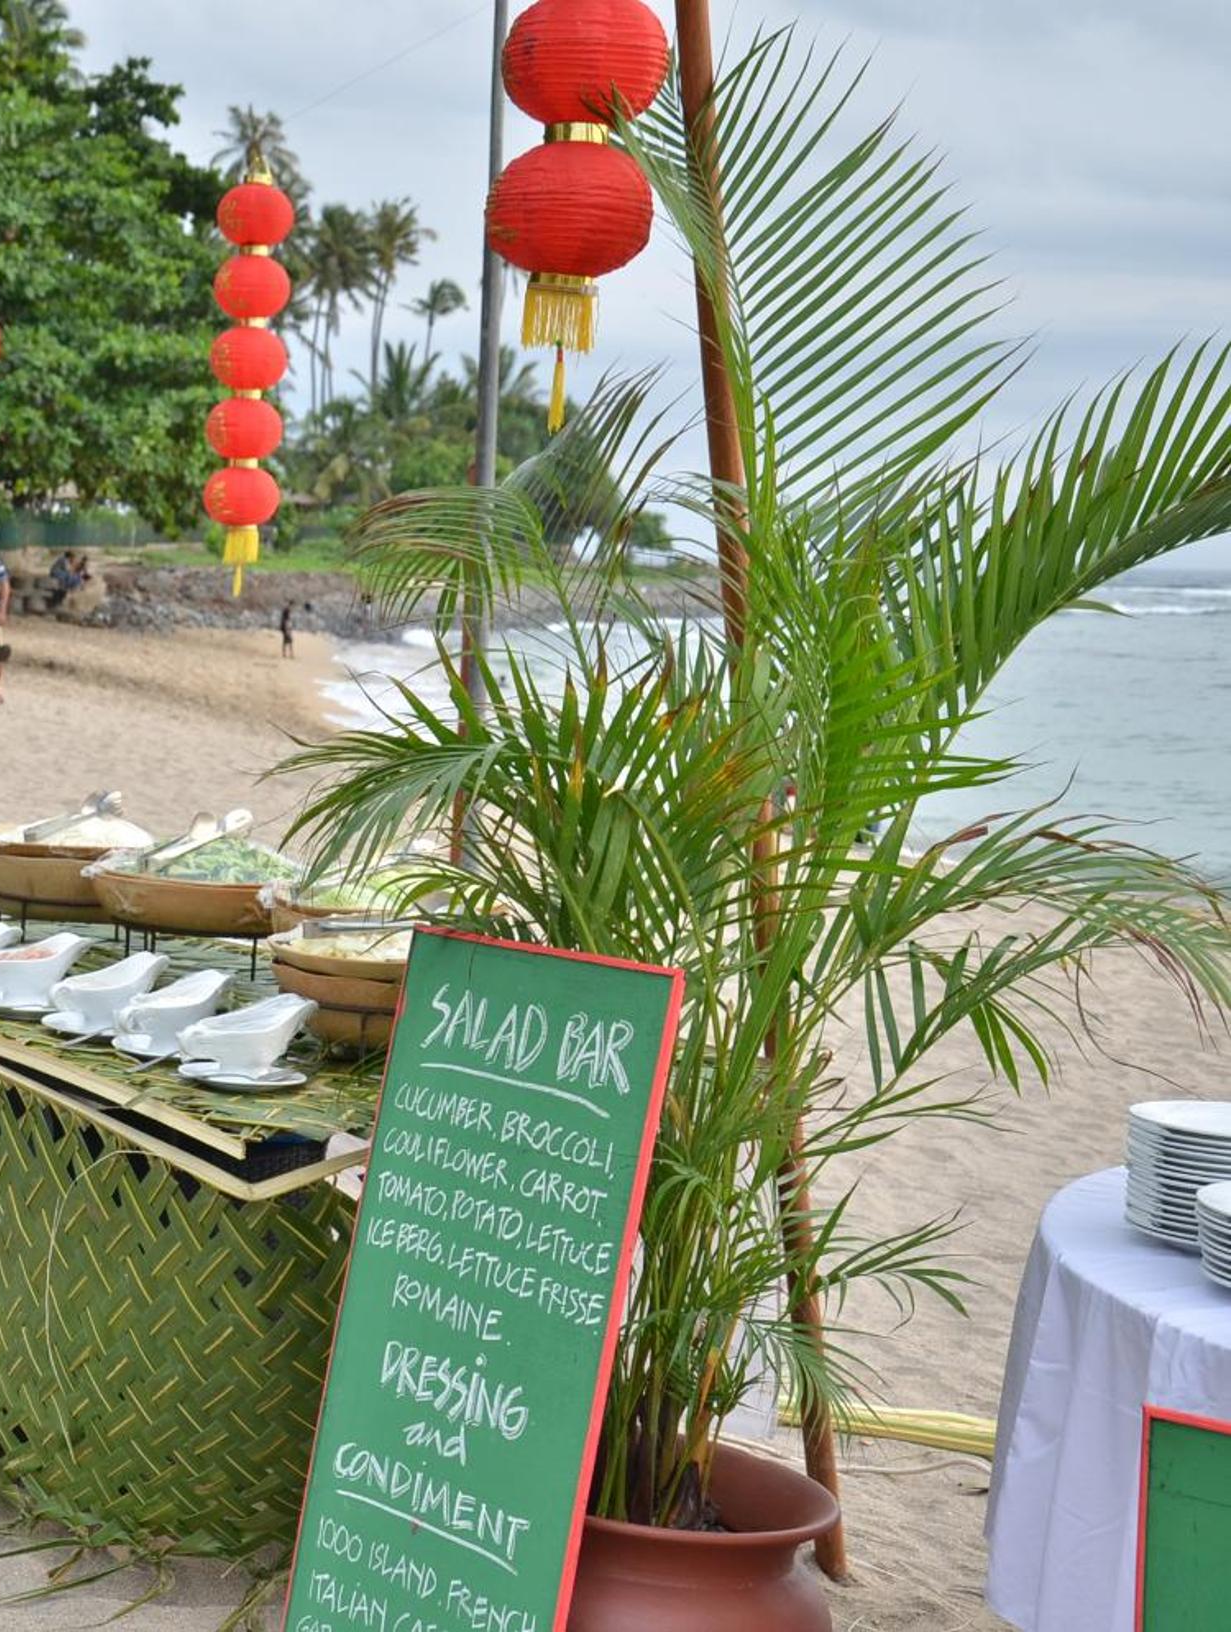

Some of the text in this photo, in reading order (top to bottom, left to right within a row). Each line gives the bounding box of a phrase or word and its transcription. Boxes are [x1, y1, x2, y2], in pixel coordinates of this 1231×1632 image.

[420, 983, 634, 1094] SALAD BAR
[448, 1243, 537, 1298] LETTUCE
[525, 1222, 613, 1275] LETTUCE
[403, 1420, 468, 1466] and
[317, 1515, 363, 1562] 1000
[446, 1579, 537, 1632] FRENCH
